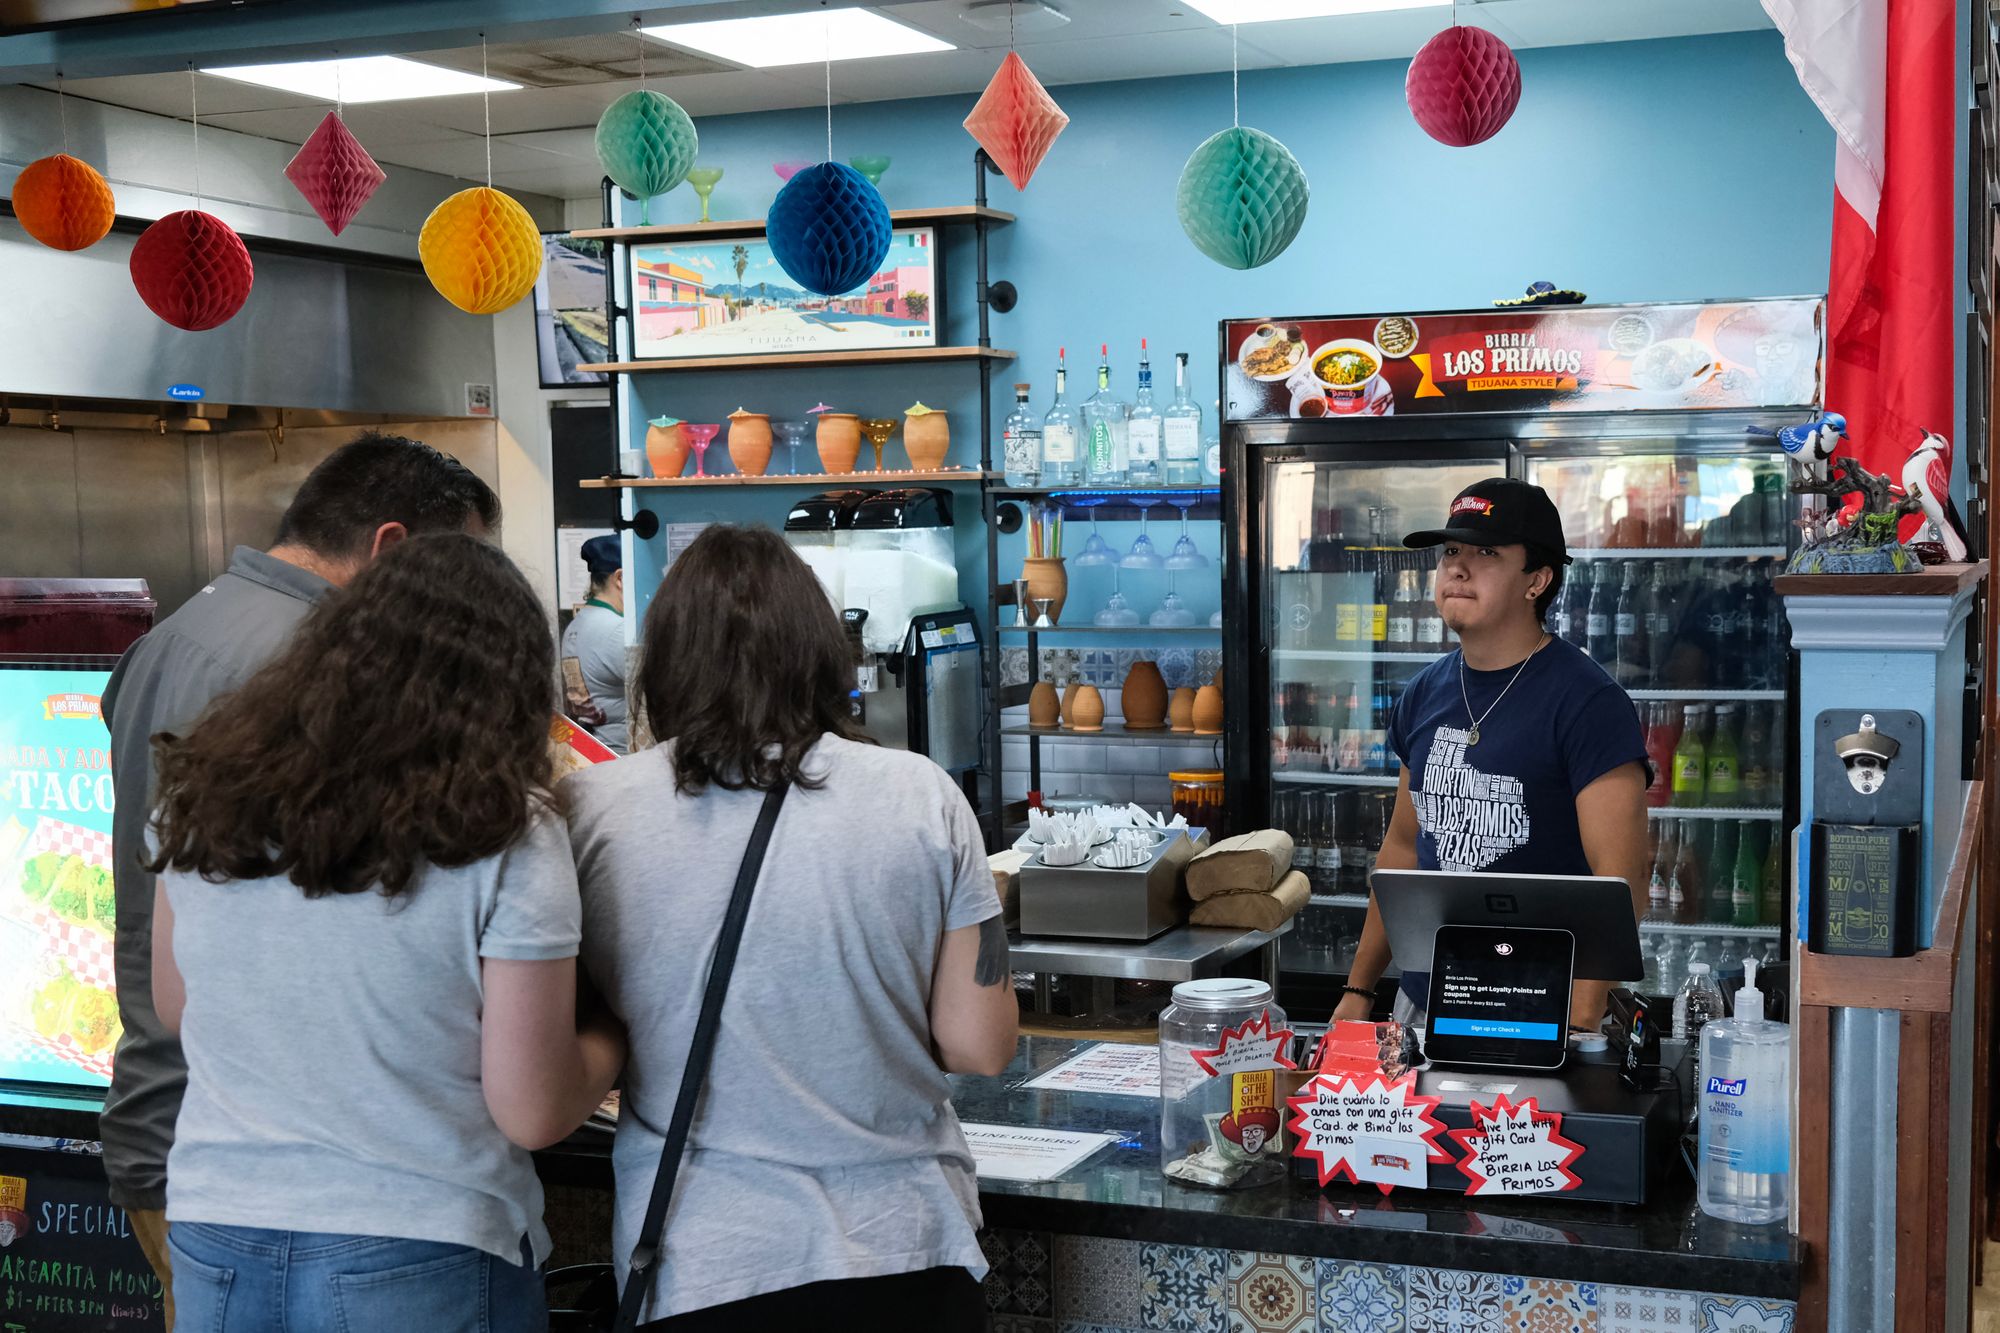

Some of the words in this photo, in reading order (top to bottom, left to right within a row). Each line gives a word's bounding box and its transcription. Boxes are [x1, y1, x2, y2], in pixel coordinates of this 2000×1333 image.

[1485, 333, 1536, 348] BIRRIA
[1443, 350, 1485, 377] LOS
[1490, 347, 1582, 374] PRIMOS
[1471, 379, 1516, 389] TIJUANA
[1520, 378, 1553, 388] STYLE
[1096, 424, 1104, 472] HORNITOS
[52, 701, 67, 712] LOS
[68, 701, 99, 713] PRIMOS
[1430, 739, 1449, 755] TACO
[55, 747, 69, 769] Y
[1423, 763, 1477, 799] HOUSTON
[1436, 796, 1461, 832] LOS
[1460, 799, 1523, 838] PRIMOS
[1830, 835, 1867, 844] BOTTLED
[1868, 836, 1890, 845] PURE
[1439, 831, 1481, 867] TEXAS
[1479, 847, 1496, 863] PICO
[1489, 986, 1511, 994] Loyalty
[1534, 987, 1546, 995] and
[1242, 1073, 1267, 1083] BIRRIA
[1248, 1083, 1267, 1094] THE
[1710, 1078, 1743, 1095] Purell
[1319, 1094, 1338, 1105] Dile
[1343, 1094, 1375, 1106] cuánto
[1380, 1094, 1390, 1105] lo
[1714, 1099, 1736, 1109] HAND
[1311, 1109, 1341, 1117] amas
[1346, 1108, 1364, 1117] con
[1368, 1109, 1386, 1118] una
[1390, 1107, 1413, 1125] gift
[1708, 1105, 1743, 1117] SANITIZER
[1347, 1121, 1359, 1132] de
[1476, 1118, 1501, 1133] Give
[1506, 1117, 1528, 1130] love
[963, 1131, 1010, 1139] NLINE
[1011, 1134, 1081, 1145] ORDERS!
[1316, 1134, 1354, 1145] Primos
[1469, 1136, 1477, 1145] a
[1482, 1135, 1505, 1151] gift
[1510, 1132, 1535, 1144] Card
[1478, 1152, 1508, 1163] from
[1485, 1163, 1532, 1177] BIRRIA
[1538, 1160, 1559, 1172] LOS
[1501, 1177, 1555, 1191] PRIMOS
[36, 1294, 74, 1314] AFTER
